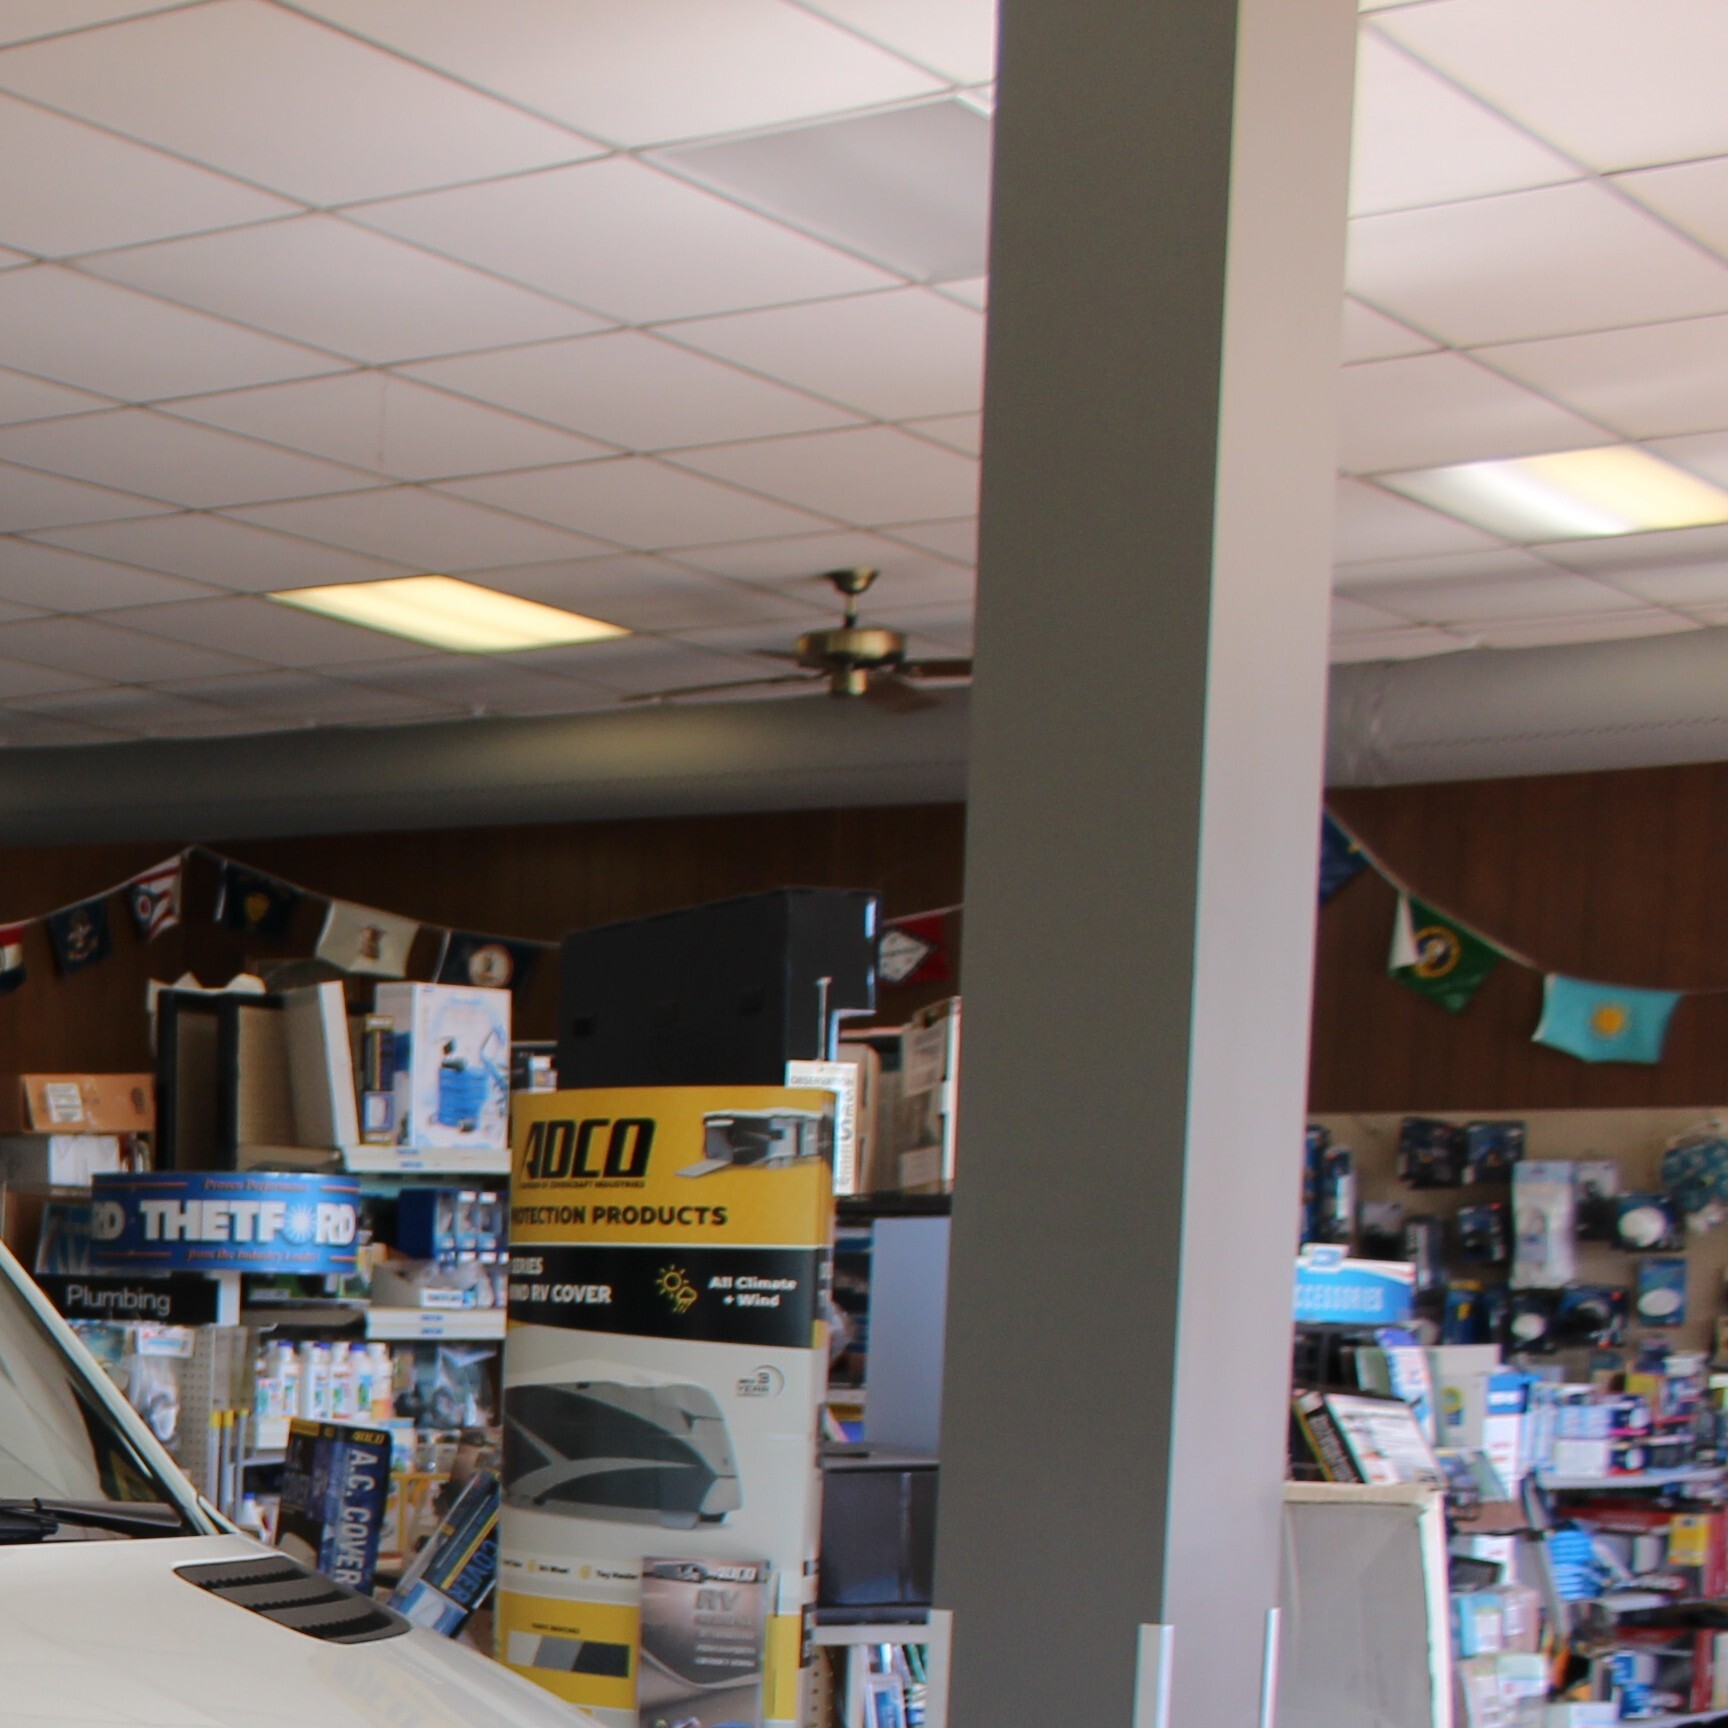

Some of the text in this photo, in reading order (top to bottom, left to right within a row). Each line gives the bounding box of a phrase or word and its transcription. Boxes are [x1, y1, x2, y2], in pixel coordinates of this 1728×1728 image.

[521, 1118, 657, 1180] ADCO
[139, 1199, 357, 1245] THETFORD
[592, 1205, 729, 1226] PRODUCTS
[530, 1283, 550, 1302] RV
[551, 1283, 613, 1304] COVER
[708, 1275, 798, 1291] All Climate
[66, 1284, 172, 1317] Plumbing
[736, 1293, 781, 1308] Wind
[336, 1506, 372, 1586] COVER
[696, 1588, 741, 1611] RV
